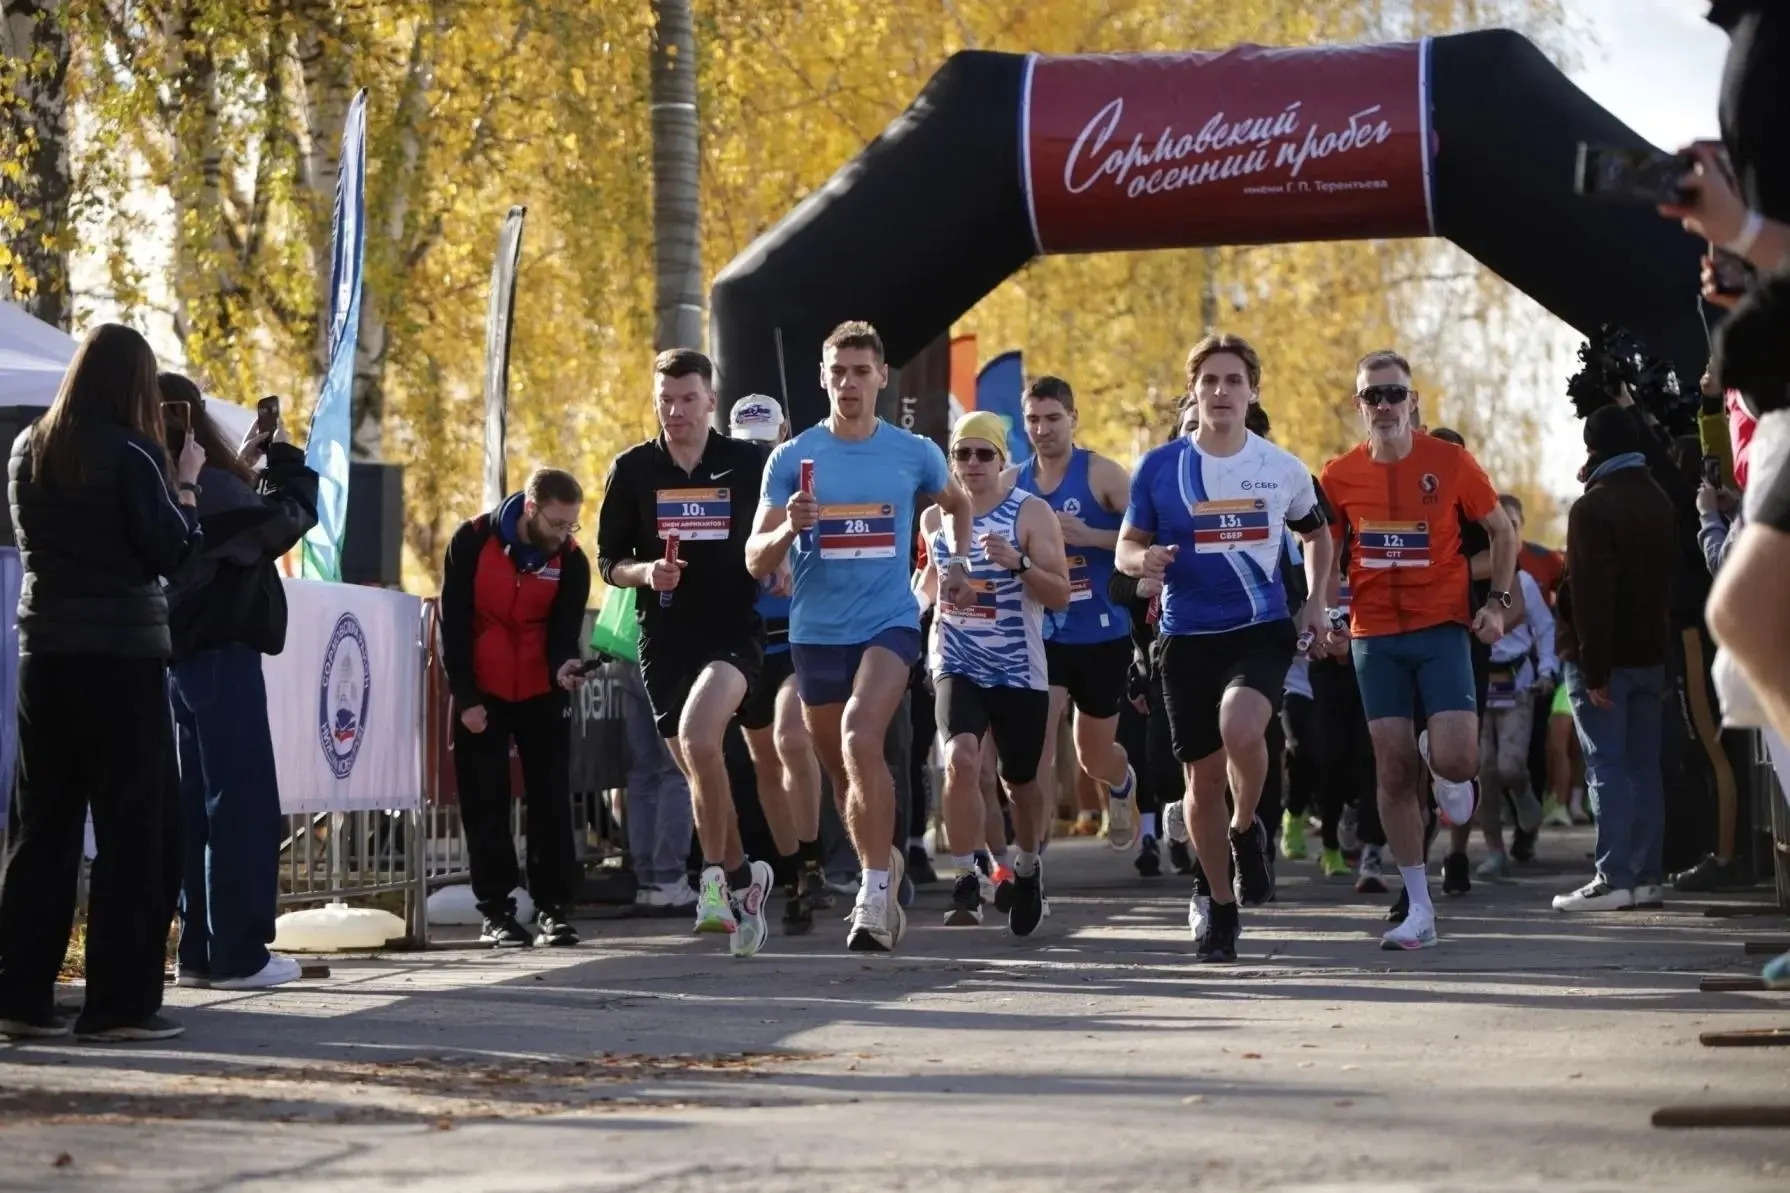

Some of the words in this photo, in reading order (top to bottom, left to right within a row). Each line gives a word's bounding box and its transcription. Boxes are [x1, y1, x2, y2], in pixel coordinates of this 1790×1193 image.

[1064, 97, 1302, 193] Сормовский
[1127, 140, 1270, 198] осенний
[1275, 104, 1391, 176] пробег
[1244, 185, 1283, 194] имени
[1314, 180, 1388, 193] Терентьева
[1220, 531, 1243, 540] СБЕР
